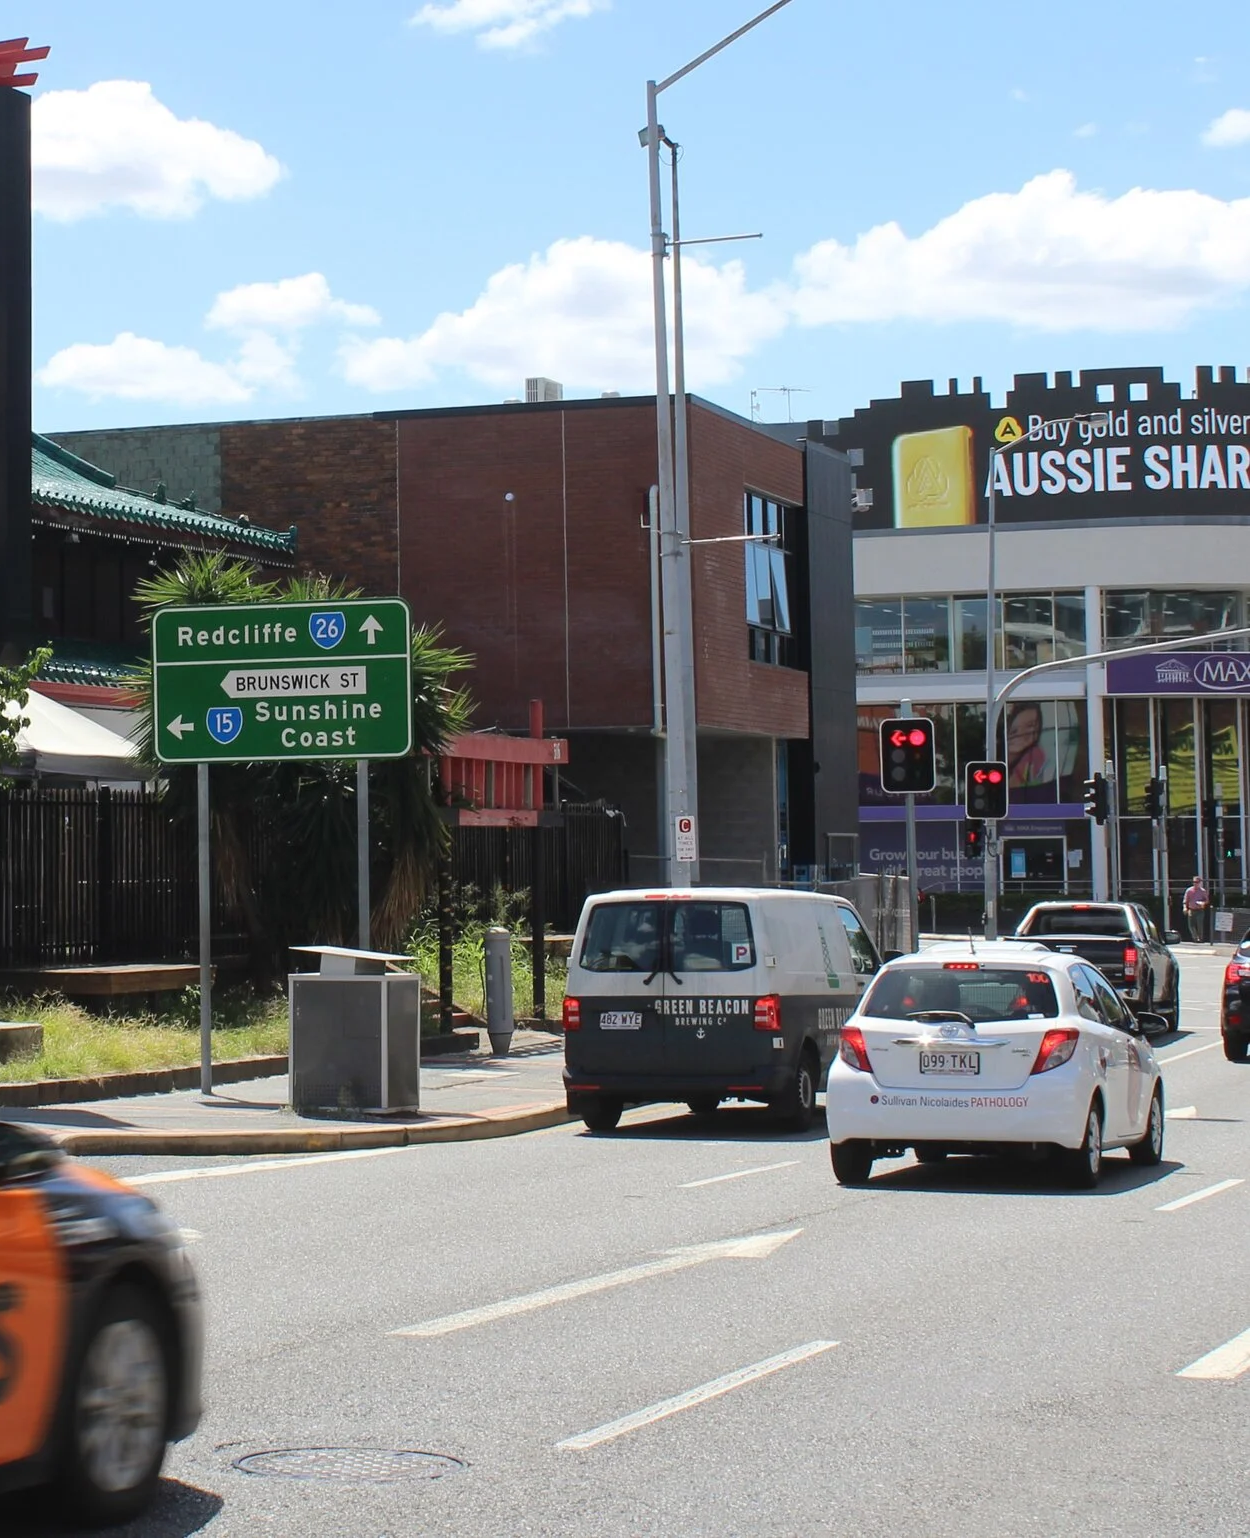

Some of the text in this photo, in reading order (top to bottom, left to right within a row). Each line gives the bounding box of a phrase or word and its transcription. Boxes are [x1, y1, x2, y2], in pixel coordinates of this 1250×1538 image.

[1028, 414, 1070, 446] Buy
[1137, 408, 1182, 435] and
[1191, 407, 1250, 435] silver
[984, 444, 1250, 498] AUSSIE SHAR
[177, 618, 339, 647] Redcliffe 26
[1202, 661, 1250, 682] MAX
[236, 672, 359, 692] BRUNSWICK ST
[215, 700, 382, 734] 15 Sunshine
[281, 726, 356, 748] Coast
[869, 848, 907, 860] Grow
[916, 850, 940, 860] our
[917, 865, 947, 877] reat
[950, 865, 984, 880] peop
[654, 999, 750, 1015] GREEN BEACON
[675, 1017, 713, 1026] BREWING
[881, 1095, 1029, 1108] Sullivan Nicolaides PATHOLOGY
